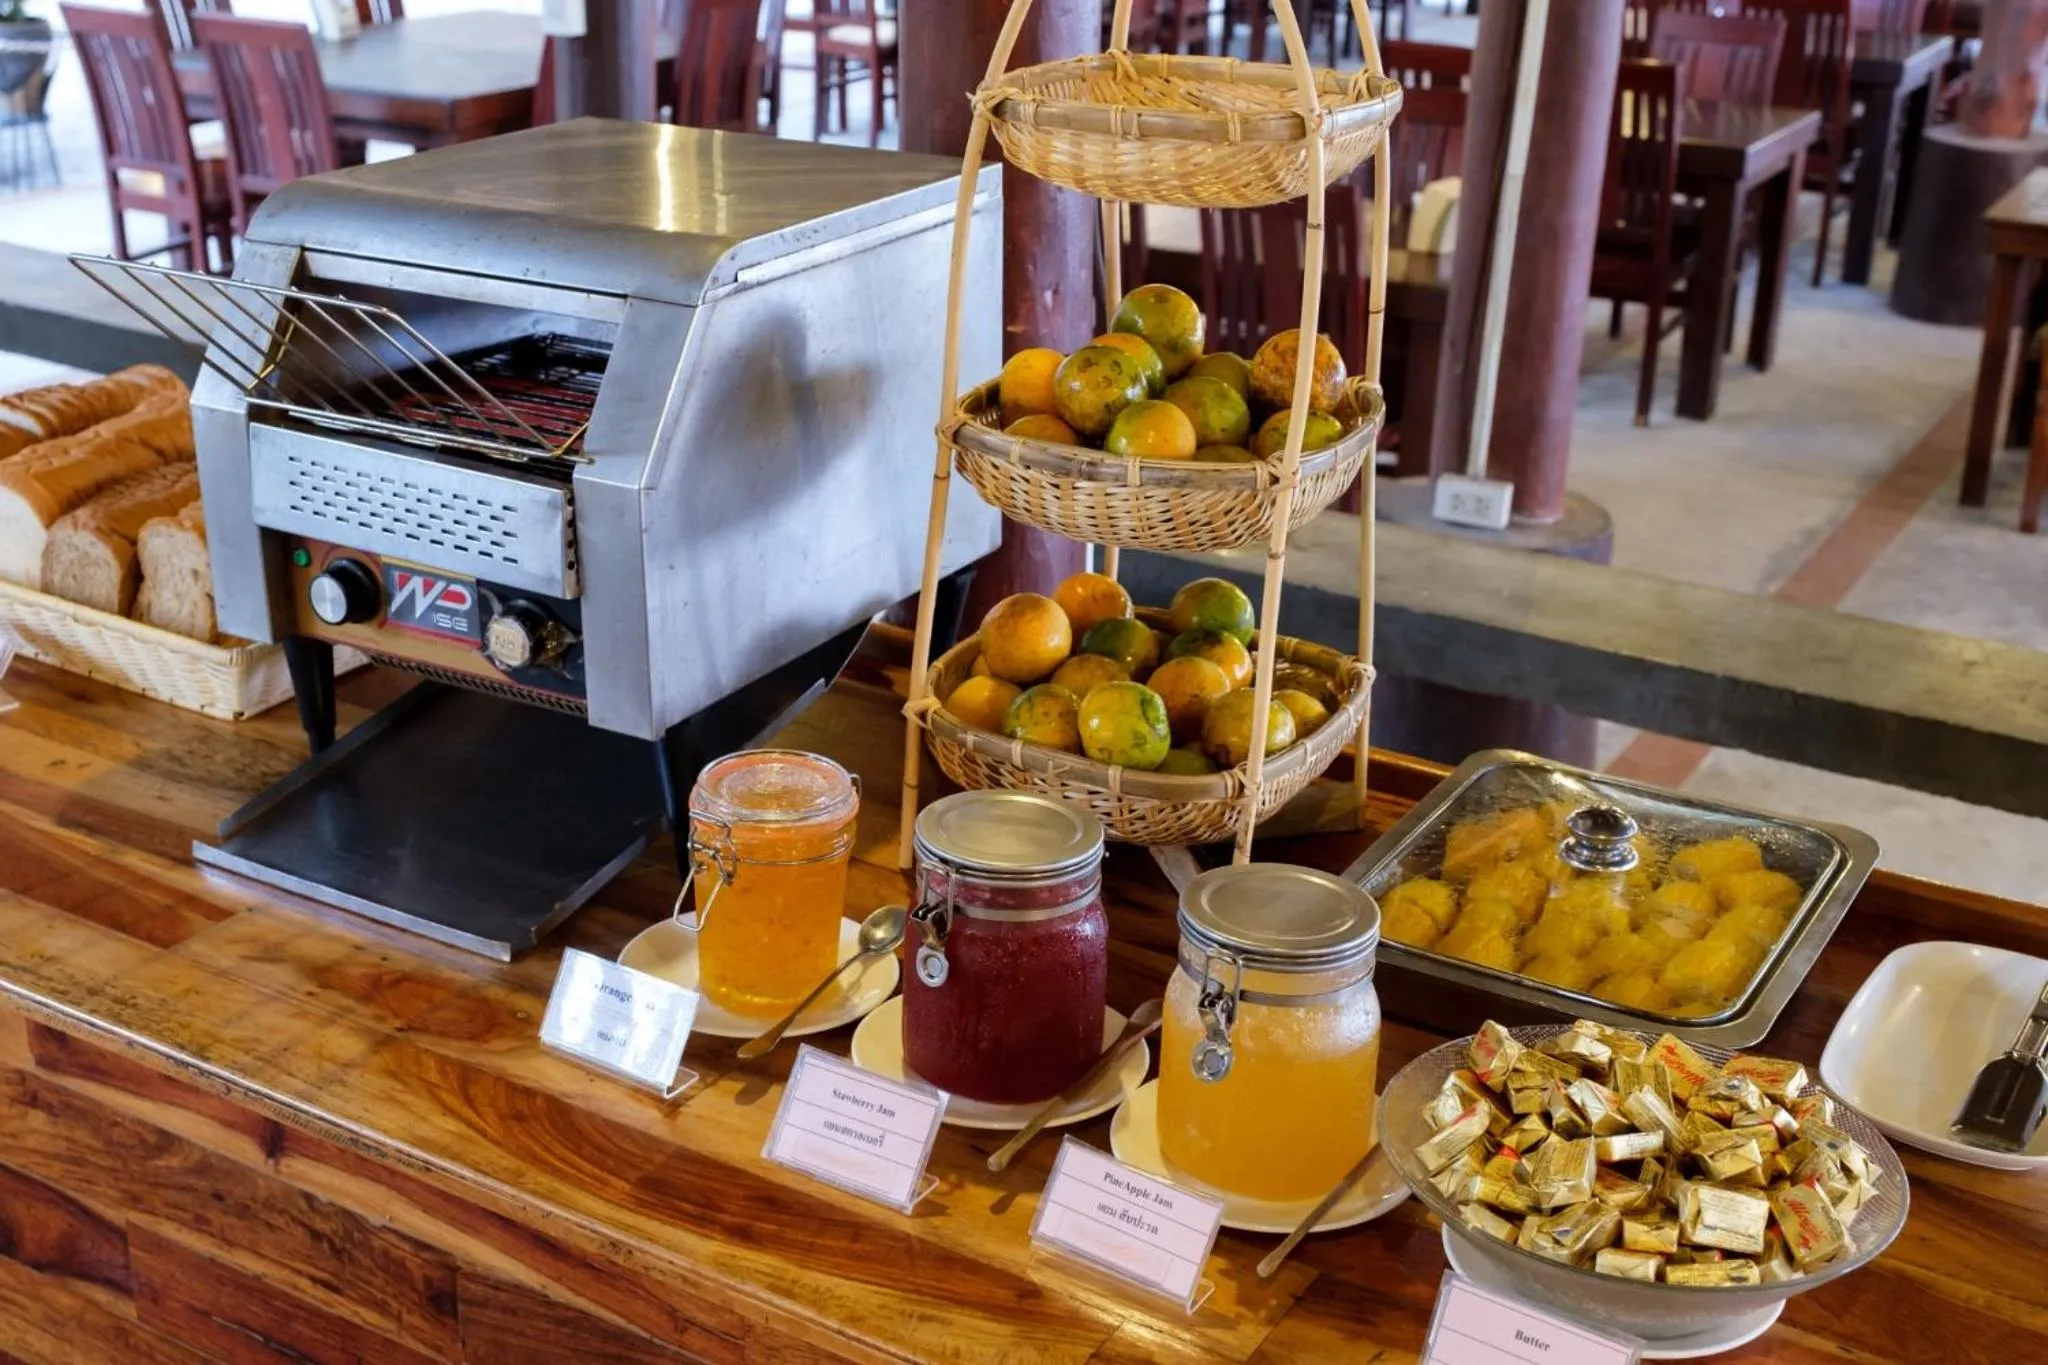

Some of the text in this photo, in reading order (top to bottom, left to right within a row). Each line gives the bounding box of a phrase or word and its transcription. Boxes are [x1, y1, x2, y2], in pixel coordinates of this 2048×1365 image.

[876, 1103, 896, 1118] Jam
[1104, 1171, 1173, 1210] PineApple Jam
[1514, 1329, 1551, 1351] Butter
